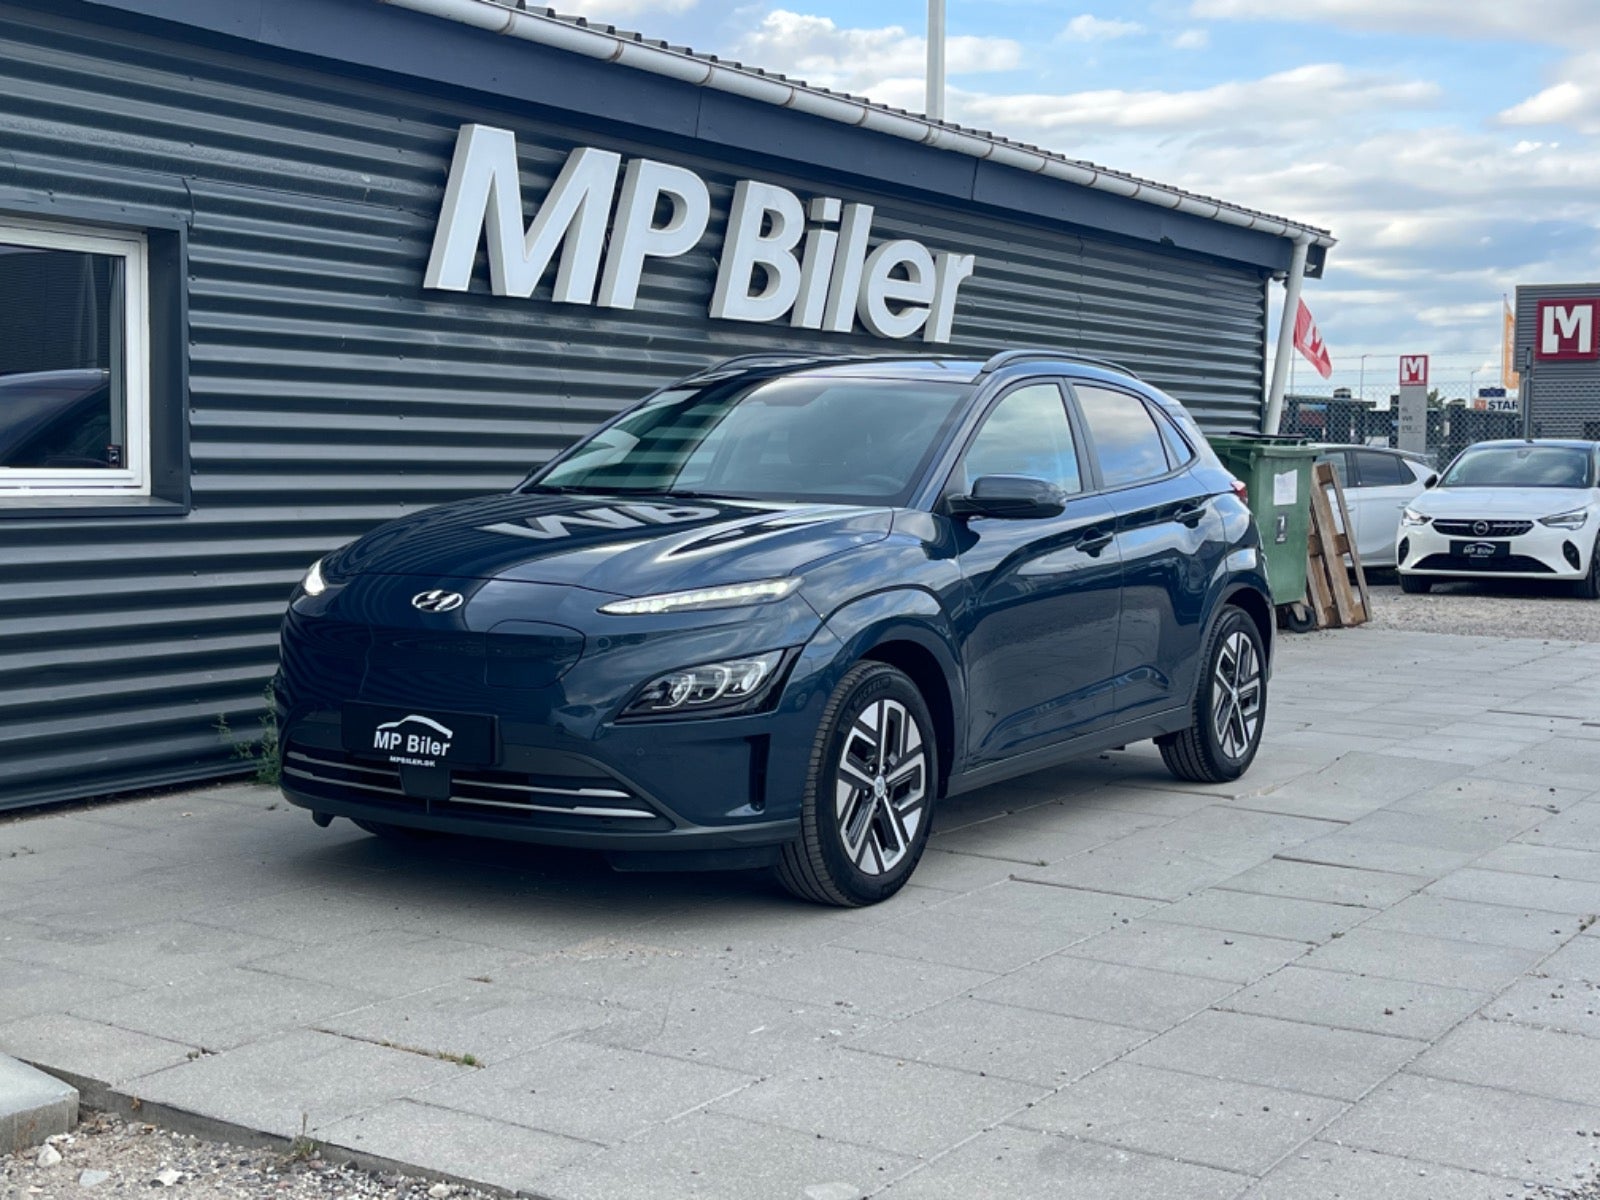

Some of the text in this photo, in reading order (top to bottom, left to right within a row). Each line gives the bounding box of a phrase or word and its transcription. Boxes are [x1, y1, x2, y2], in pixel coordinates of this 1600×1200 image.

[423, 123, 975, 344] MP Biler
[373, 731, 451, 757] MP Biler
[389, 755, 436, 767] MPBILER.DK
